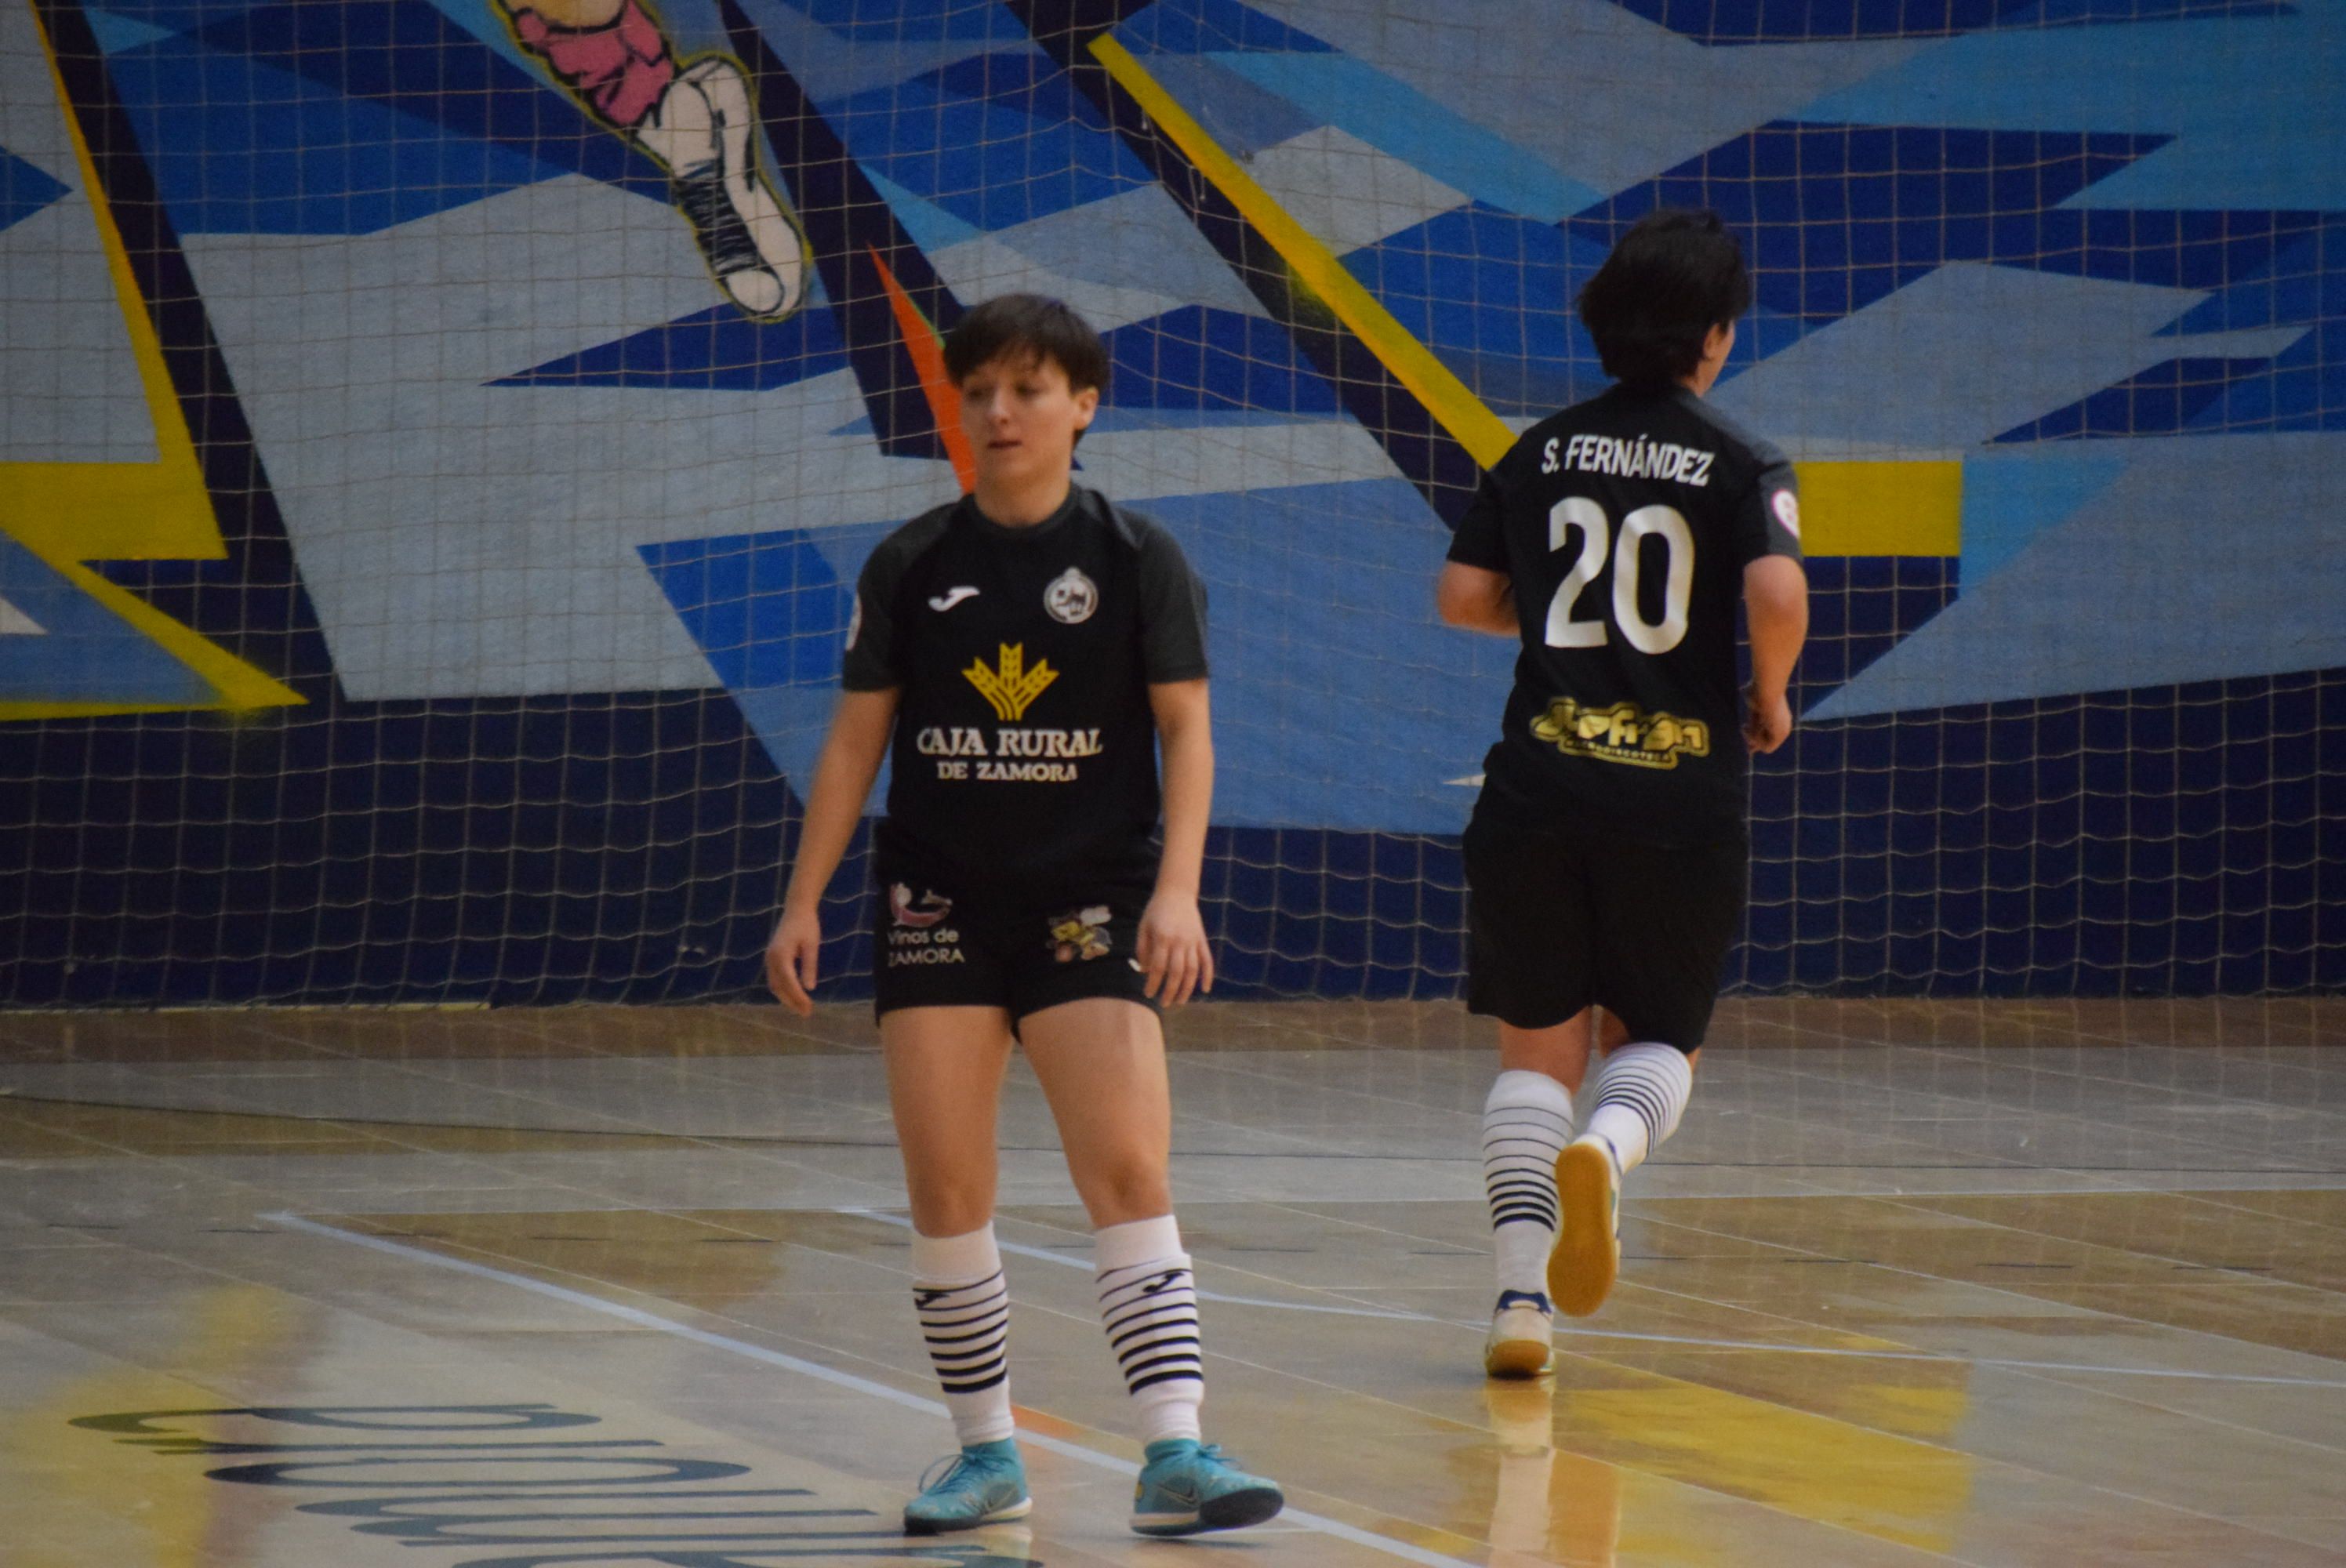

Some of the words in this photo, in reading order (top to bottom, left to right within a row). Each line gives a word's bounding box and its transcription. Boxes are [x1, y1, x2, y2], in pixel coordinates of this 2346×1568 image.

[1542, 436, 1559, 474] S.
[1565, 434, 1715, 486] FERNÁNDEZ
[1545, 496, 1695, 655] 20
[917, 727, 988, 757] CAJA
[995, 728, 1103, 758] RURAL
[937, 762, 968, 779] DE
[976, 762, 1078, 782] ZAMORA
[933, 927, 960, 946] de
